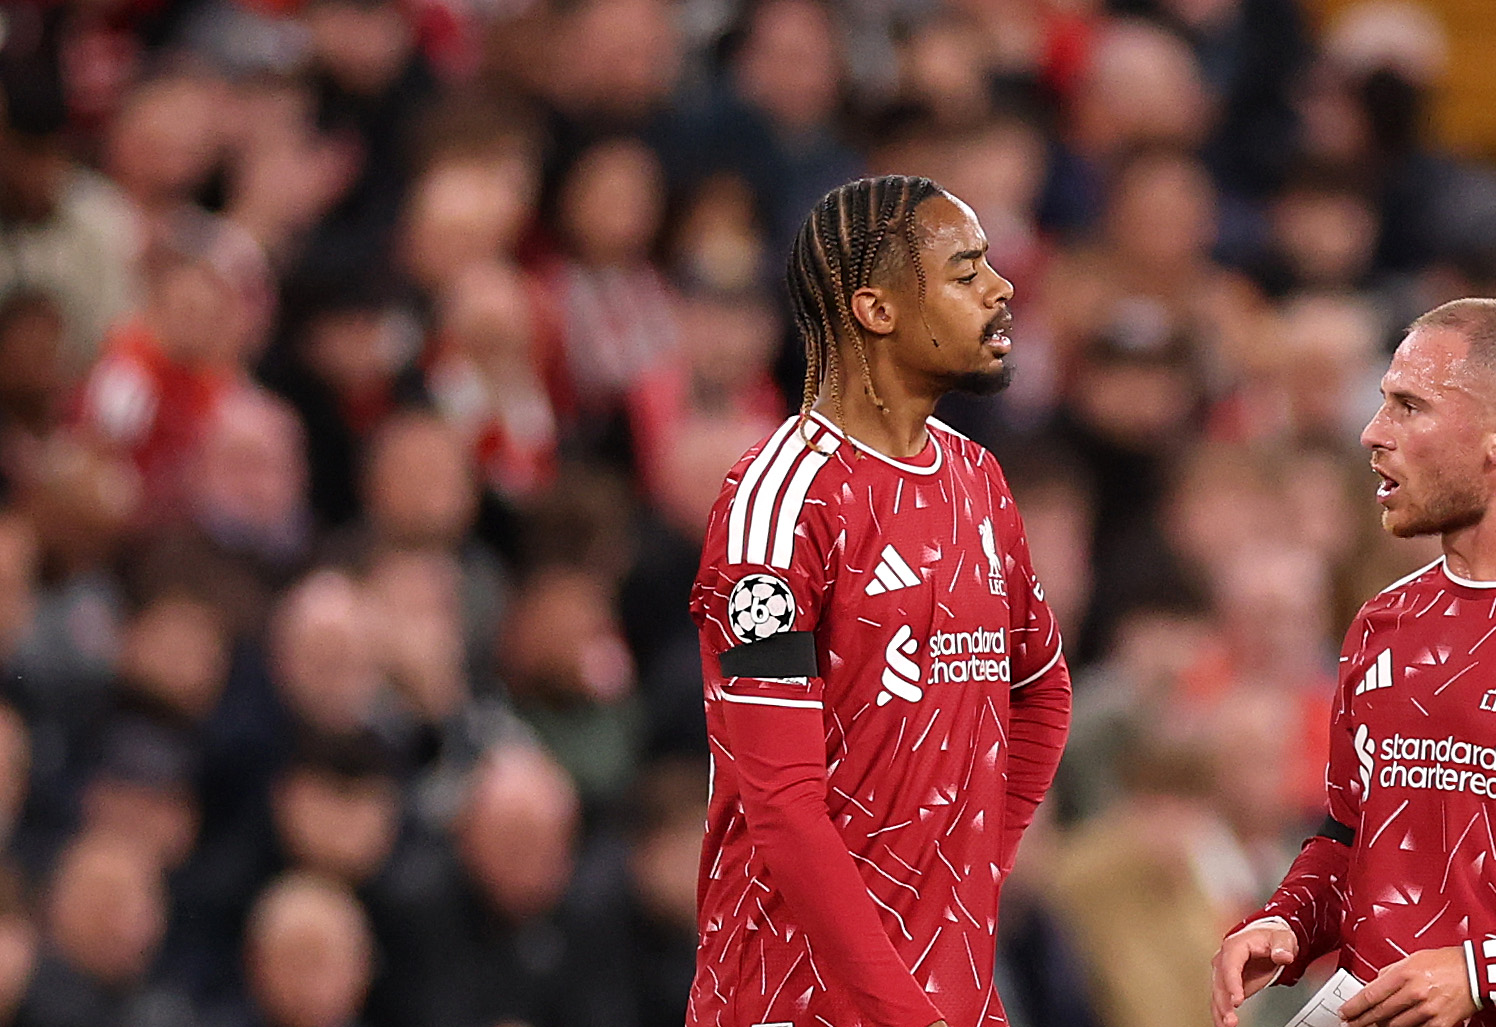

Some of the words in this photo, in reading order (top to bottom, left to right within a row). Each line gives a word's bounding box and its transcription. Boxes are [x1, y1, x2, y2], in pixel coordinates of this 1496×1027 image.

[750, 596, 770, 624] 6
[929, 626, 1005, 658] standard
[927, 655, 1011, 685] charted
